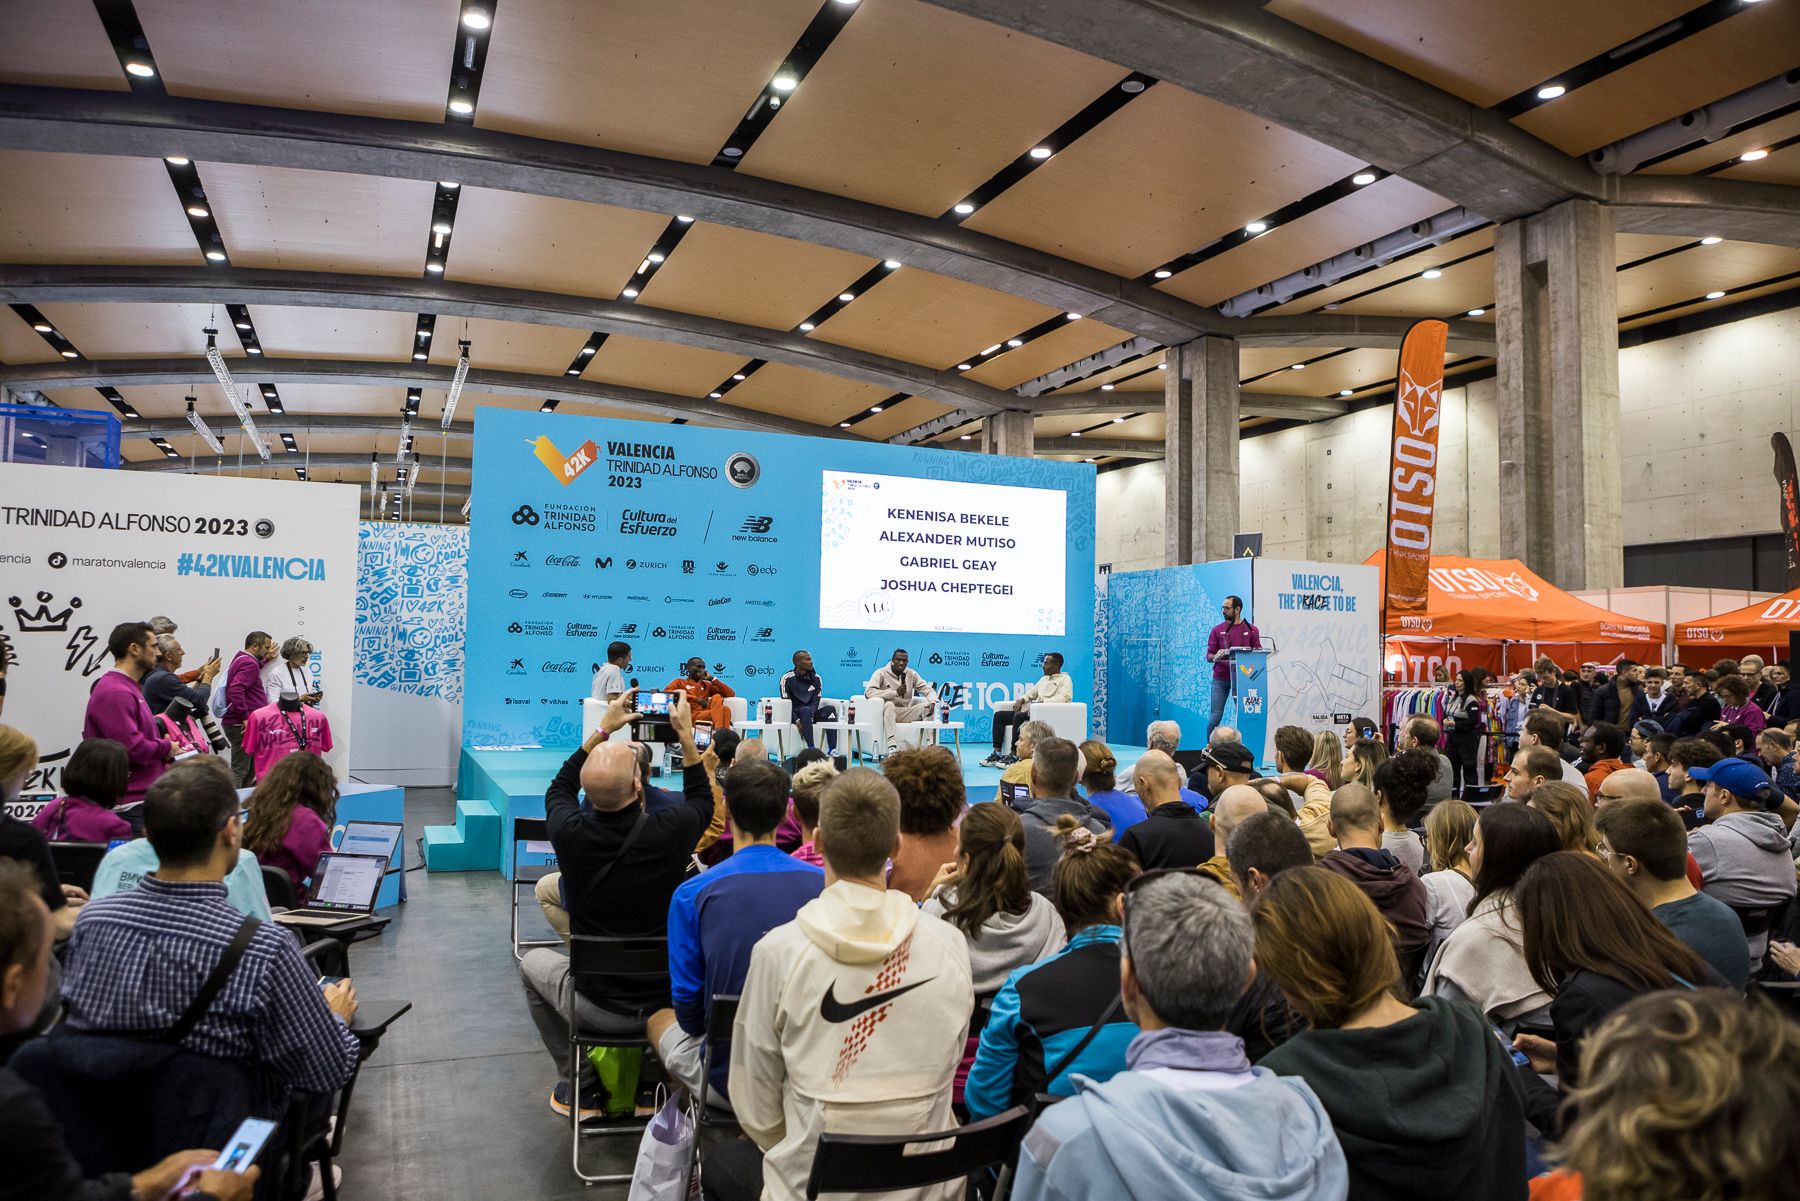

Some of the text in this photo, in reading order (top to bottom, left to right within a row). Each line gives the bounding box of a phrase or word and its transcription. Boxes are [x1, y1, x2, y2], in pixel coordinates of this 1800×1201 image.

[607, 441, 675, 460] VALENCIA
[563, 449, 591, 478] 42K
[606, 459, 661, 475] TRINIDAD
[662, 463, 718, 480] ALFONSO
[608, 475, 642, 488] 2023
[1390, 435, 1437, 550] OTSO
[544, 503, 596, 512] FUNDACIÓN
[1, 507, 249, 536] TRINIDAD ALFONSO 2023
[544, 511, 596, 522] TRINIDAD
[622, 508, 677, 524] Cultura del
[887, 508, 1009, 527] KENENISA BEKELE
[544, 522, 596, 532] ALFONSO
[620, 522, 677, 537] Esfuerzo
[748, 535, 778, 543] balance
[879, 531, 1016, 549] ALEXANDER MUTISO
[72, 556, 166, 569] maratonvalencia
[177, 553, 326, 581] #42KVALENCIA
[760, 565, 777, 576] edp
[900, 556, 997, 571] GABRIEL GEAY
[881, 579, 1014, 595] JOSHUA CHEPTEGEI
[1292, 573, 1344, 594] VALENCIA,
[1428, 567, 1501, 592] OTSO
[418, 600, 445, 614] 42K
[1278, 593, 1295, 609] THE
[1333, 596, 1344, 612] TO
[1346, 596, 1356, 612] BE
[1760, 598, 1800, 619] OT
[567, 622, 591, 630] Cultura
[1400, 616, 1421, 628] OTSO
[1686, 627, 1709, 639] OTSO
[982, 652, 1004, 660] Cultura
[757, 665, 775, 677] edp
[416, 684, 443, 699] 42K
[976, 682, 1011, 711] TO
[1244, 705, 1254, 713] TO
